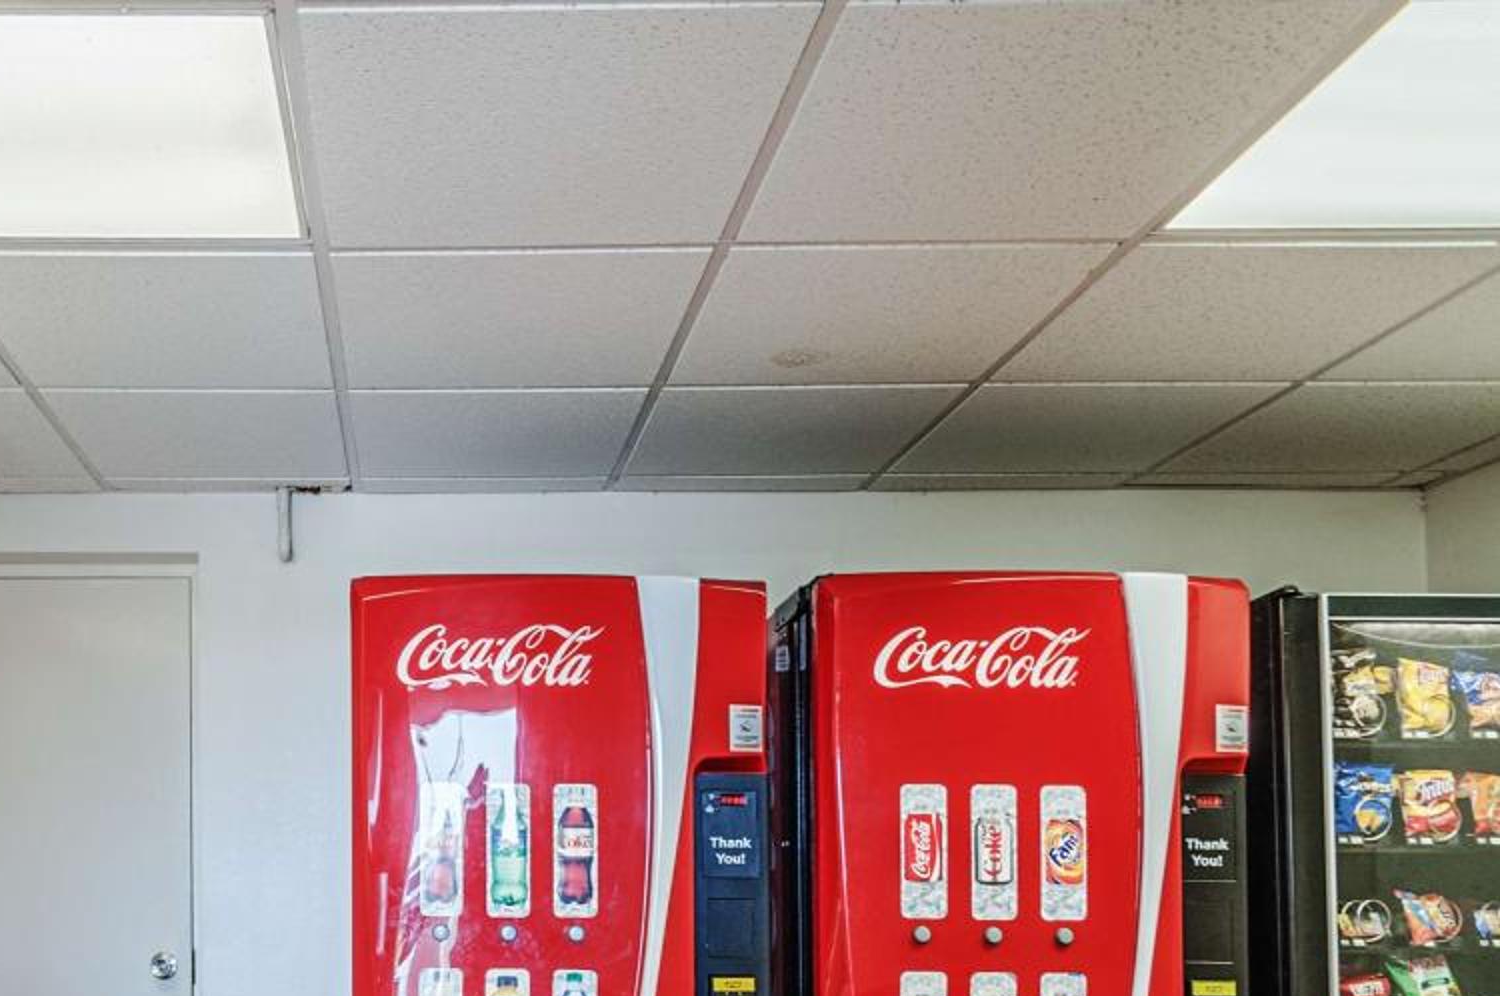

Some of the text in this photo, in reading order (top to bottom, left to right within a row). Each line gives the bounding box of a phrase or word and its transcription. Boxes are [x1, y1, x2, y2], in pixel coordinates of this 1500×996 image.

[396, 623, 606, 691] Coca-Cola
[873, 625, 1092, 689] Coca-Cola
[709, 836, 752, 849] Thank
[1185, 837, 1230, 850] Thank
[715, 853, 746, 865] You!
[1191, 854, 1223, 867] You!
